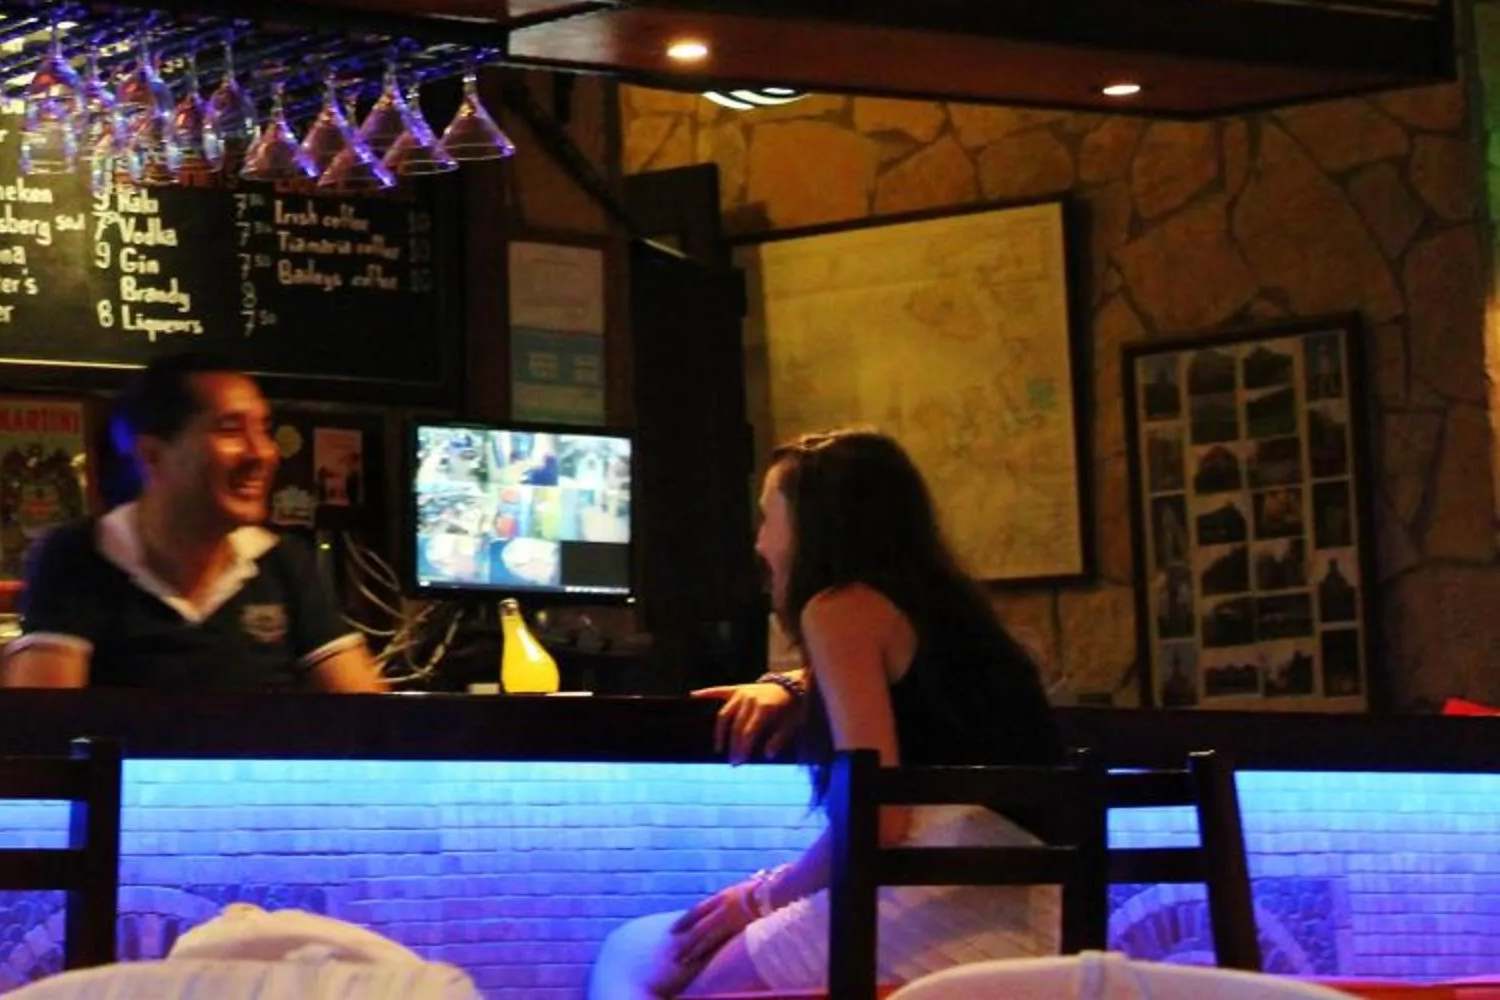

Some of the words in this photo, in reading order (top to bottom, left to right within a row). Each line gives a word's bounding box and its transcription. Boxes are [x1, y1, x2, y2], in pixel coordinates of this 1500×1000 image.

[274, 199, 318, 226] Irish
[119, 217, 178, 246] Vodka
[97, 242, 111, 269] 9
[120, 248, 159, 273] Gin
[121, 277, 190, 313] Brandy
[99, 300, 114, 327] 8
[122, 305, 204, 342] Liqueurs
